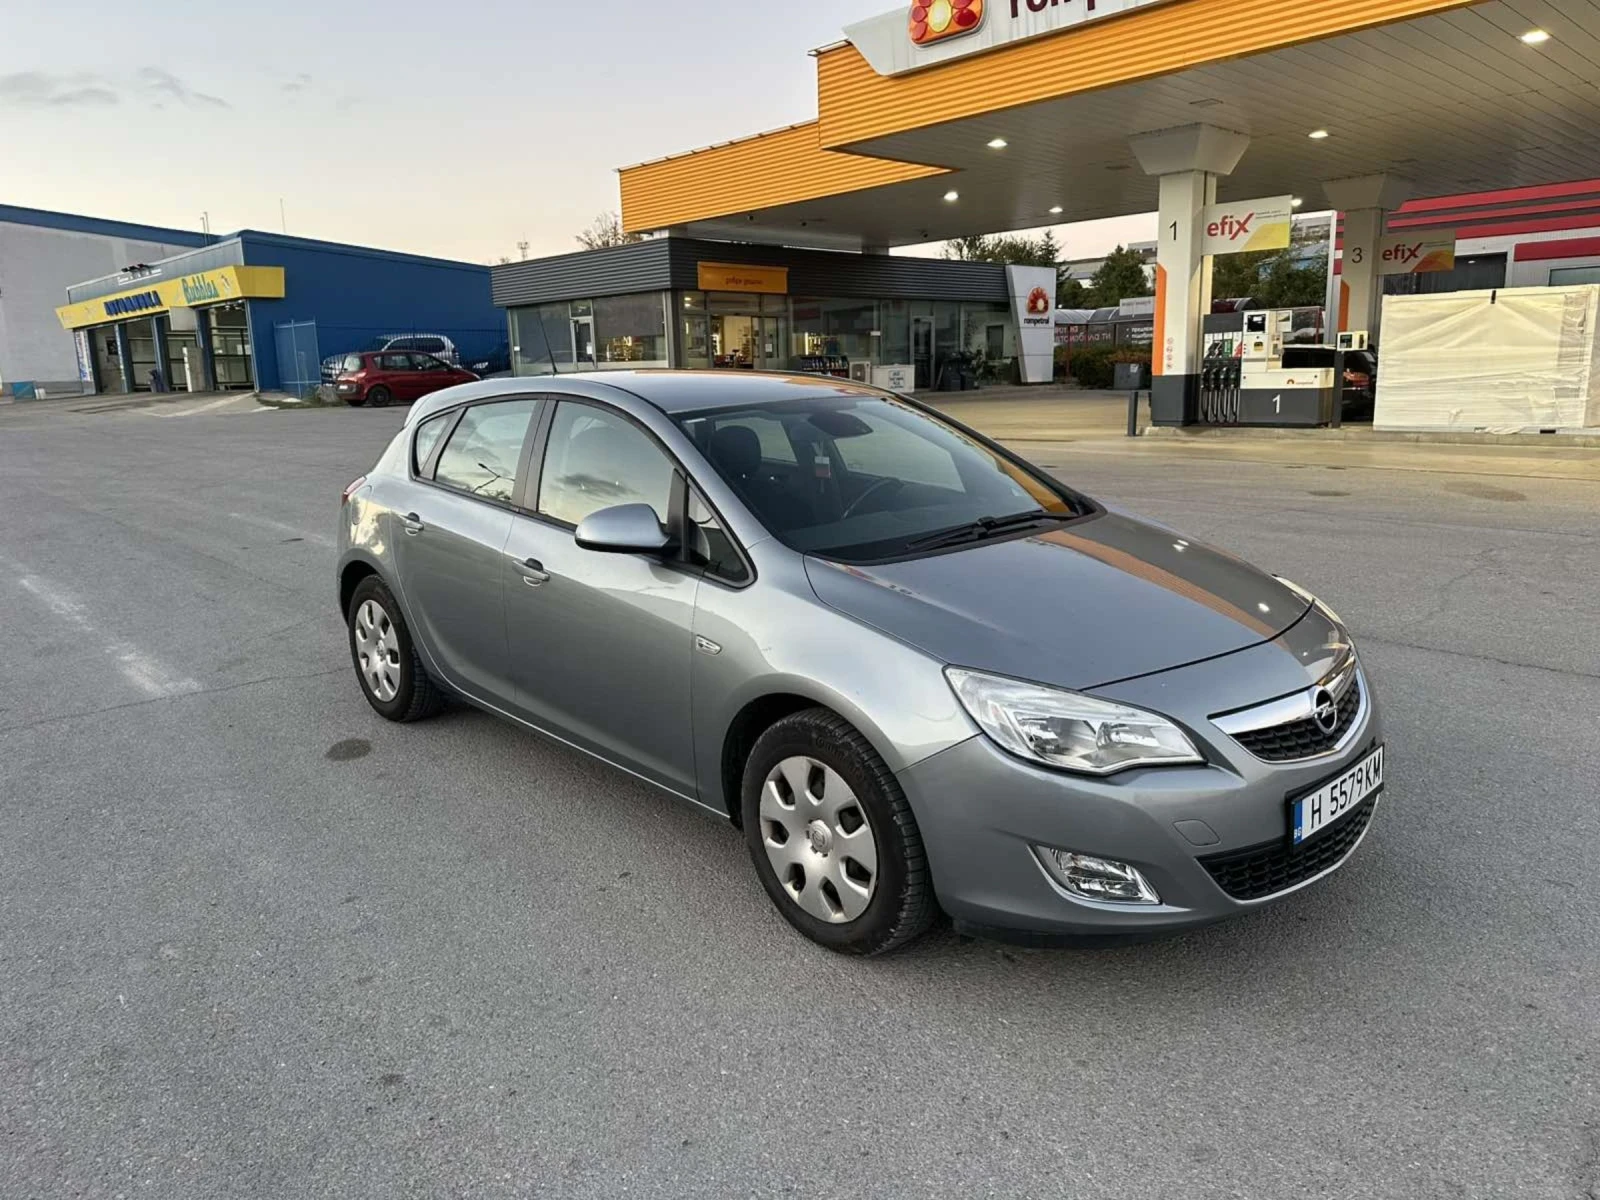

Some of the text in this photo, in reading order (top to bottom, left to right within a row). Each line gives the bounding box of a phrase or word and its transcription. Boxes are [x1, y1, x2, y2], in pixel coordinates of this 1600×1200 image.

[1169, 220, 1178, 240] 1
[1206, 212, 1254, 240] efix
[1351, 247, 1363, 263] 3
[1382, 242, 1424, 264] efix
[1272, 395, 1281, 414] 1
[1310, 793, 1322, 829] H
